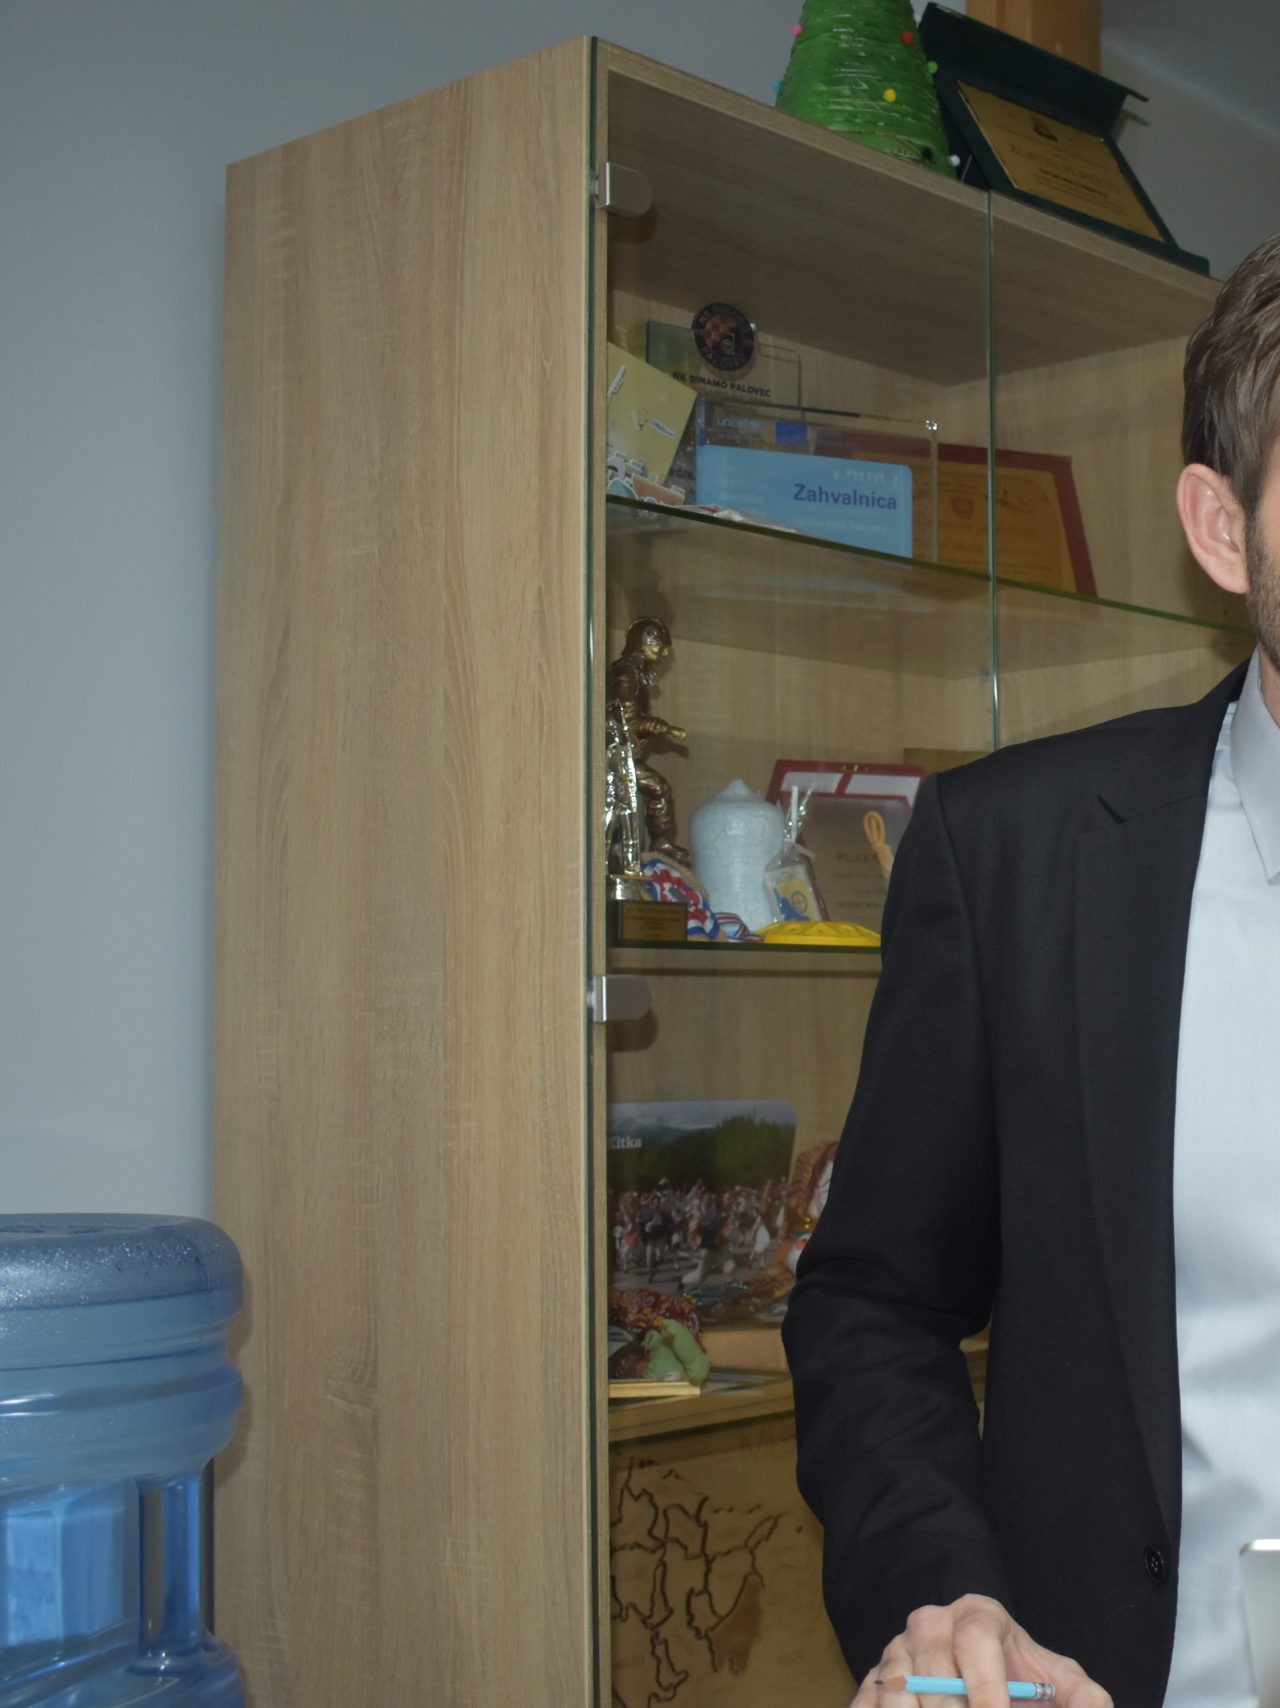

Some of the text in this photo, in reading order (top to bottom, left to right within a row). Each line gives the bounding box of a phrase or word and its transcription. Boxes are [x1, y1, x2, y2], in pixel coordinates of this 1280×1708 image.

[689, 374, 728, 389] DINAMO
[730, 383, 771, 398] PALOVEC
[793, 483, 898, 511] Zahvalnica
